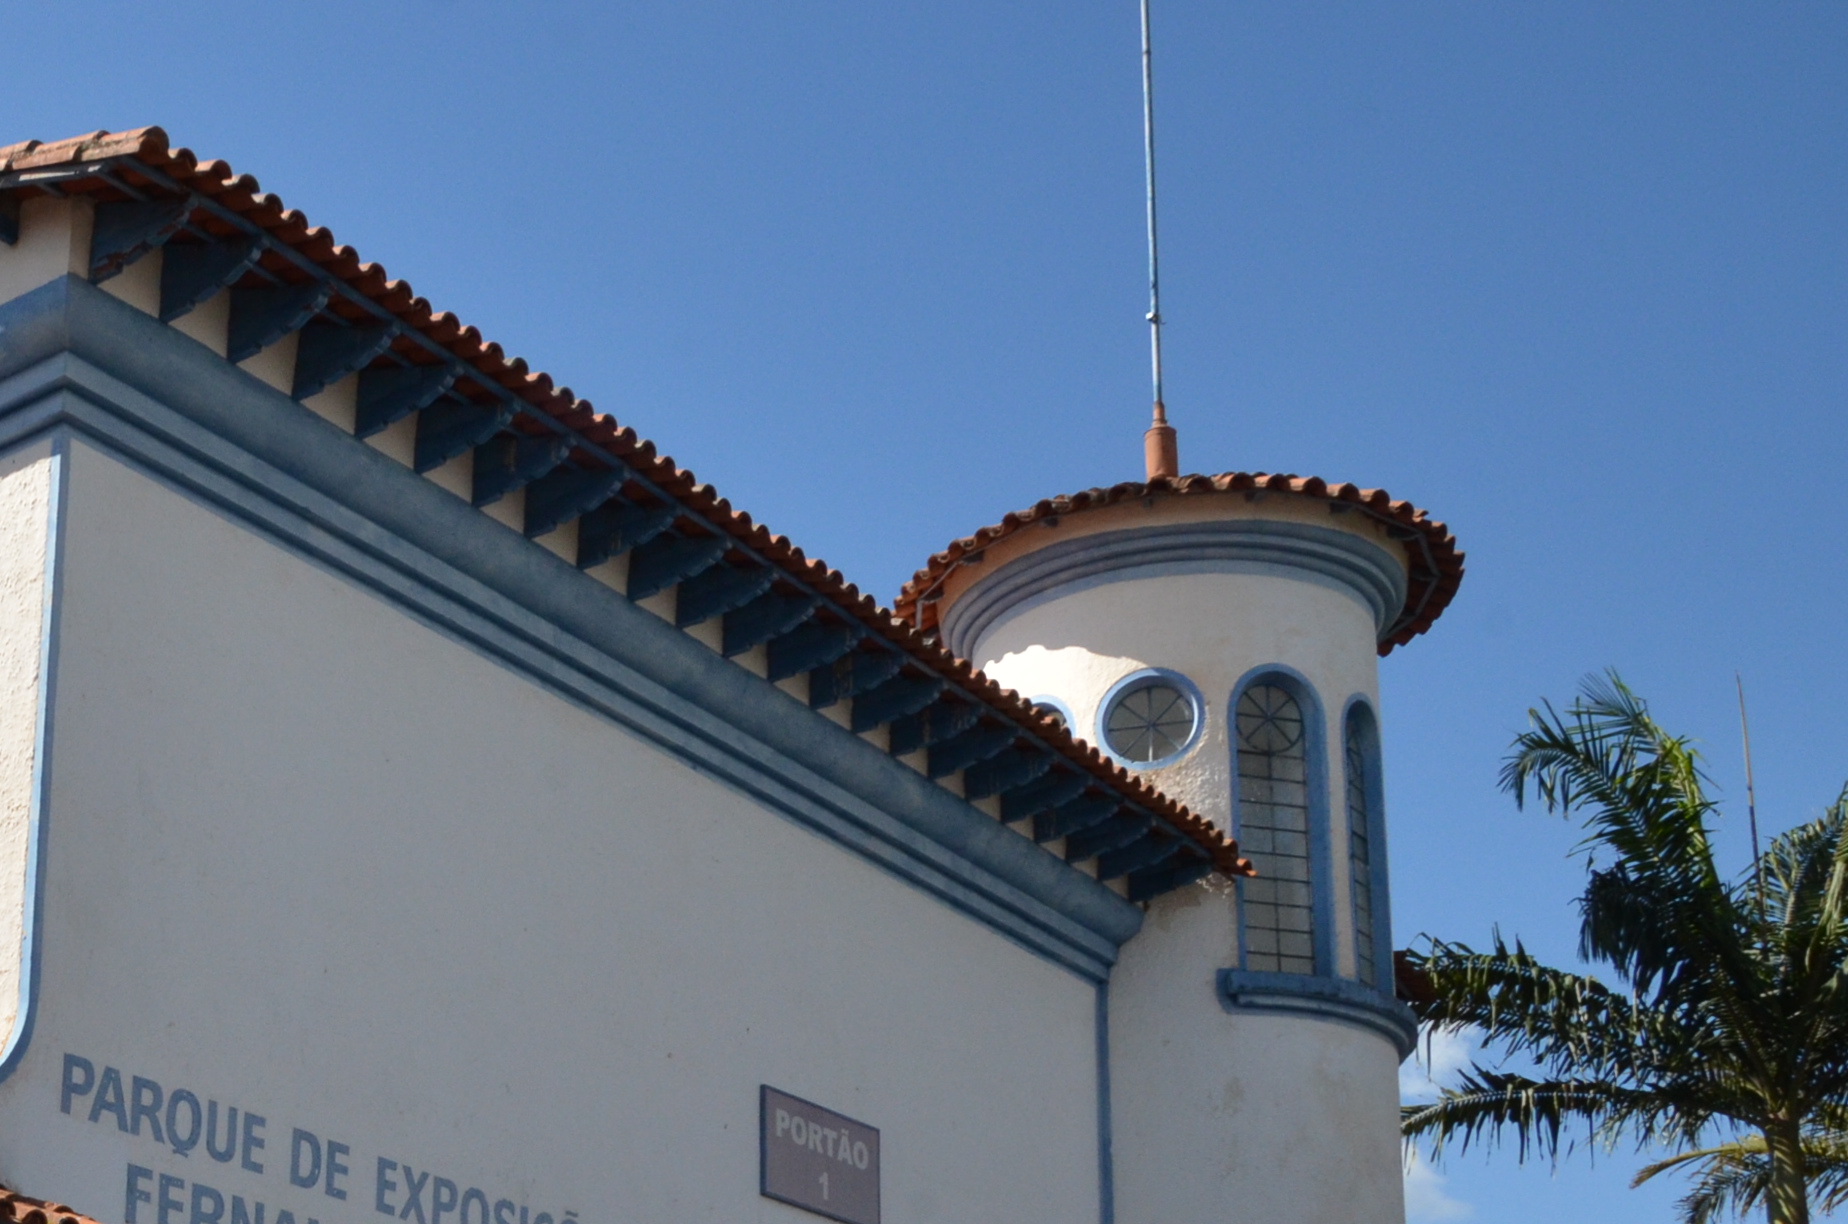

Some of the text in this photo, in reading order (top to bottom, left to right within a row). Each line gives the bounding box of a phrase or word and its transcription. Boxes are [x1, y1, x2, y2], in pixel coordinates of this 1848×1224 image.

[59, 1052, 267, 1174] PARQUE
[289, 1126, 350, 1201] DE
[775, 1109, 869, 1170] PORTÃO
[818, 1172, 829, 1200] 1
